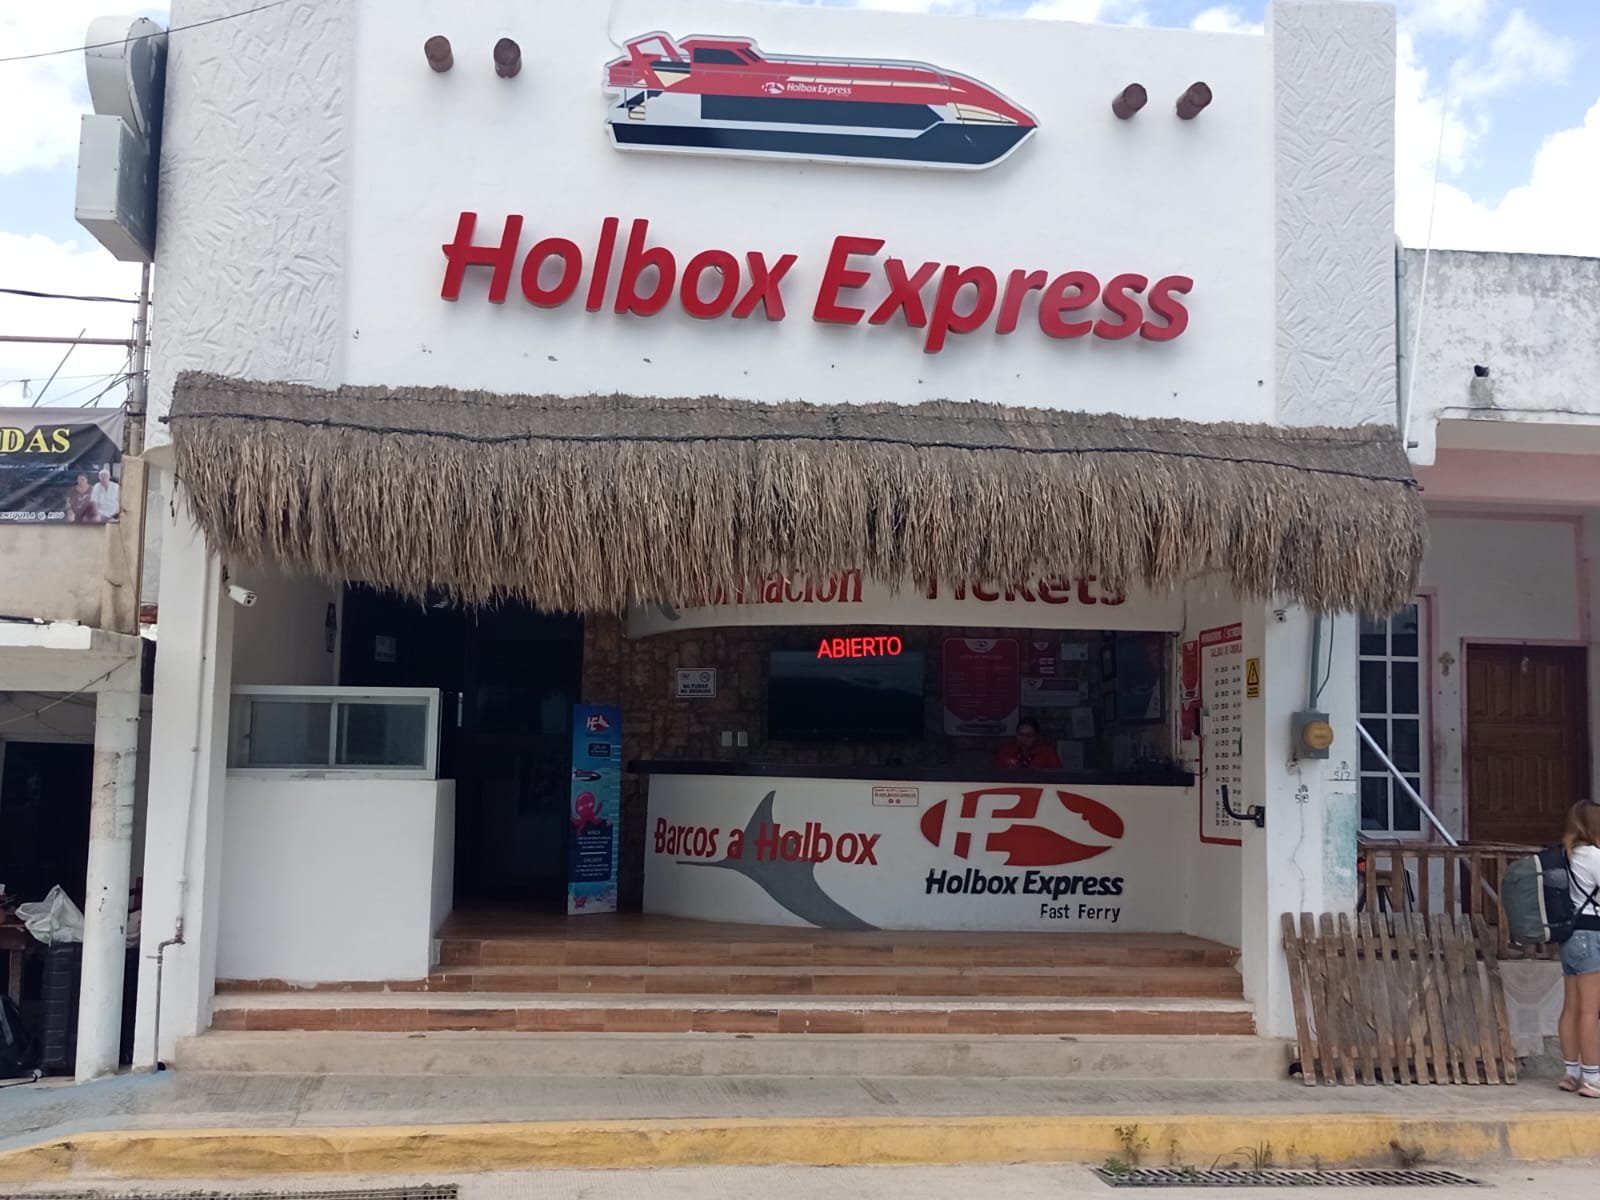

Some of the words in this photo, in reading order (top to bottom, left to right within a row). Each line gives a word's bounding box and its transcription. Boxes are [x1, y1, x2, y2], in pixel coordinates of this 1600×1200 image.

[786, 82, 817, 93] Holbox
[817, 84, 852, 96] Express
[441, 212, 797, 320] Holbox
[813, 235, 1193, 353] Express
[817, 636, 902, 658] ABIERTO
[654, 817, 719, 858] Barcos
[727, 828, 745, 860] a
[753, 822, 882, 866] Holbox
[926, 867, 1018, 895] Holbox
[1022, 870, 1124, 901] Express
[1040, 903, 1070, 919] Fast
[1078, 903, 1121, 924] Ferry
